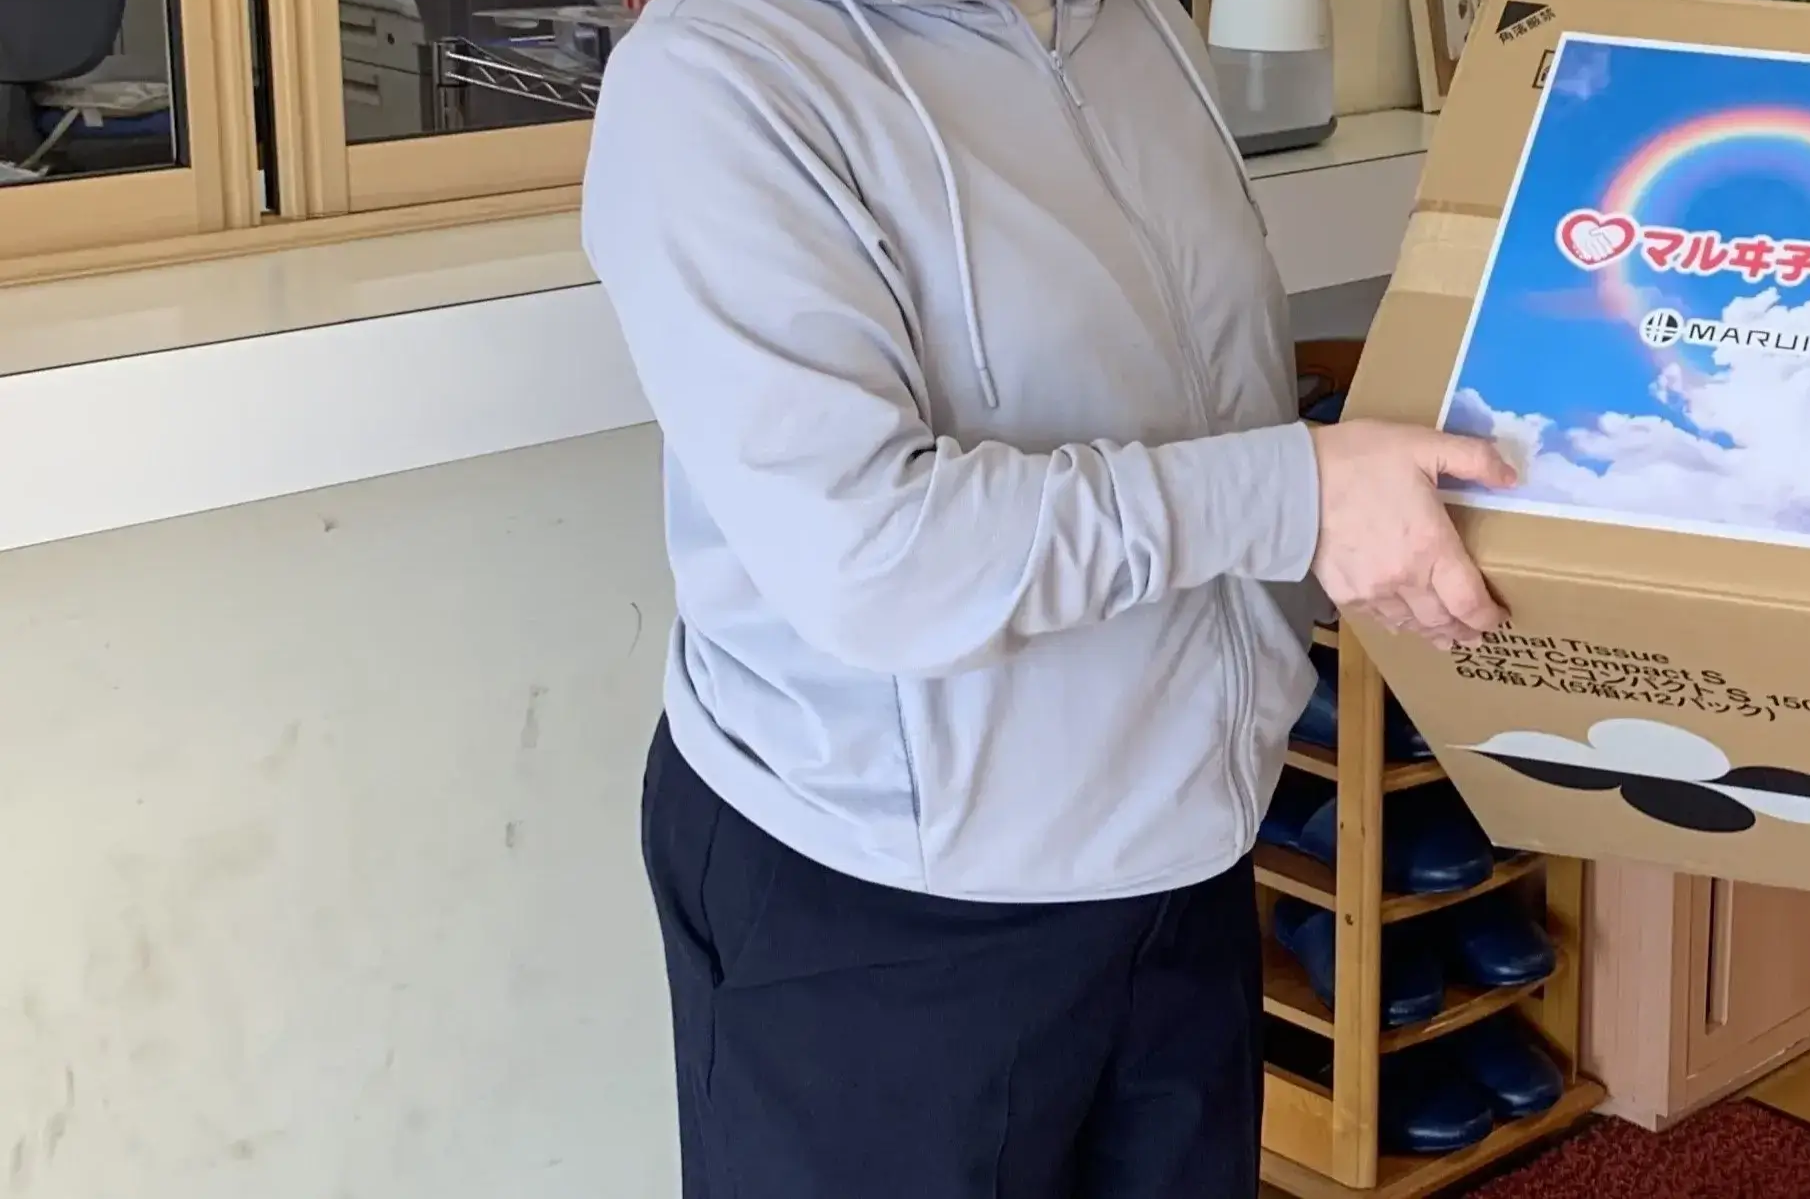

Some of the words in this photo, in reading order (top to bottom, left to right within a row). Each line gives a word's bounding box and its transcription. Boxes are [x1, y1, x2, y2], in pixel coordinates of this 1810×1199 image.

[1688, 322, 1810, 352] MARUI
[1481, 630, 1556, 649] ginal
[1561, 638, 1669, 664] Tissue
[1451, 651, 1714, 697] スマートコンパクト
[1726, 687, 1752, 703] S
[1544, 650, 1694, 682] Compact
[1701, 669, 1726, 686] S
